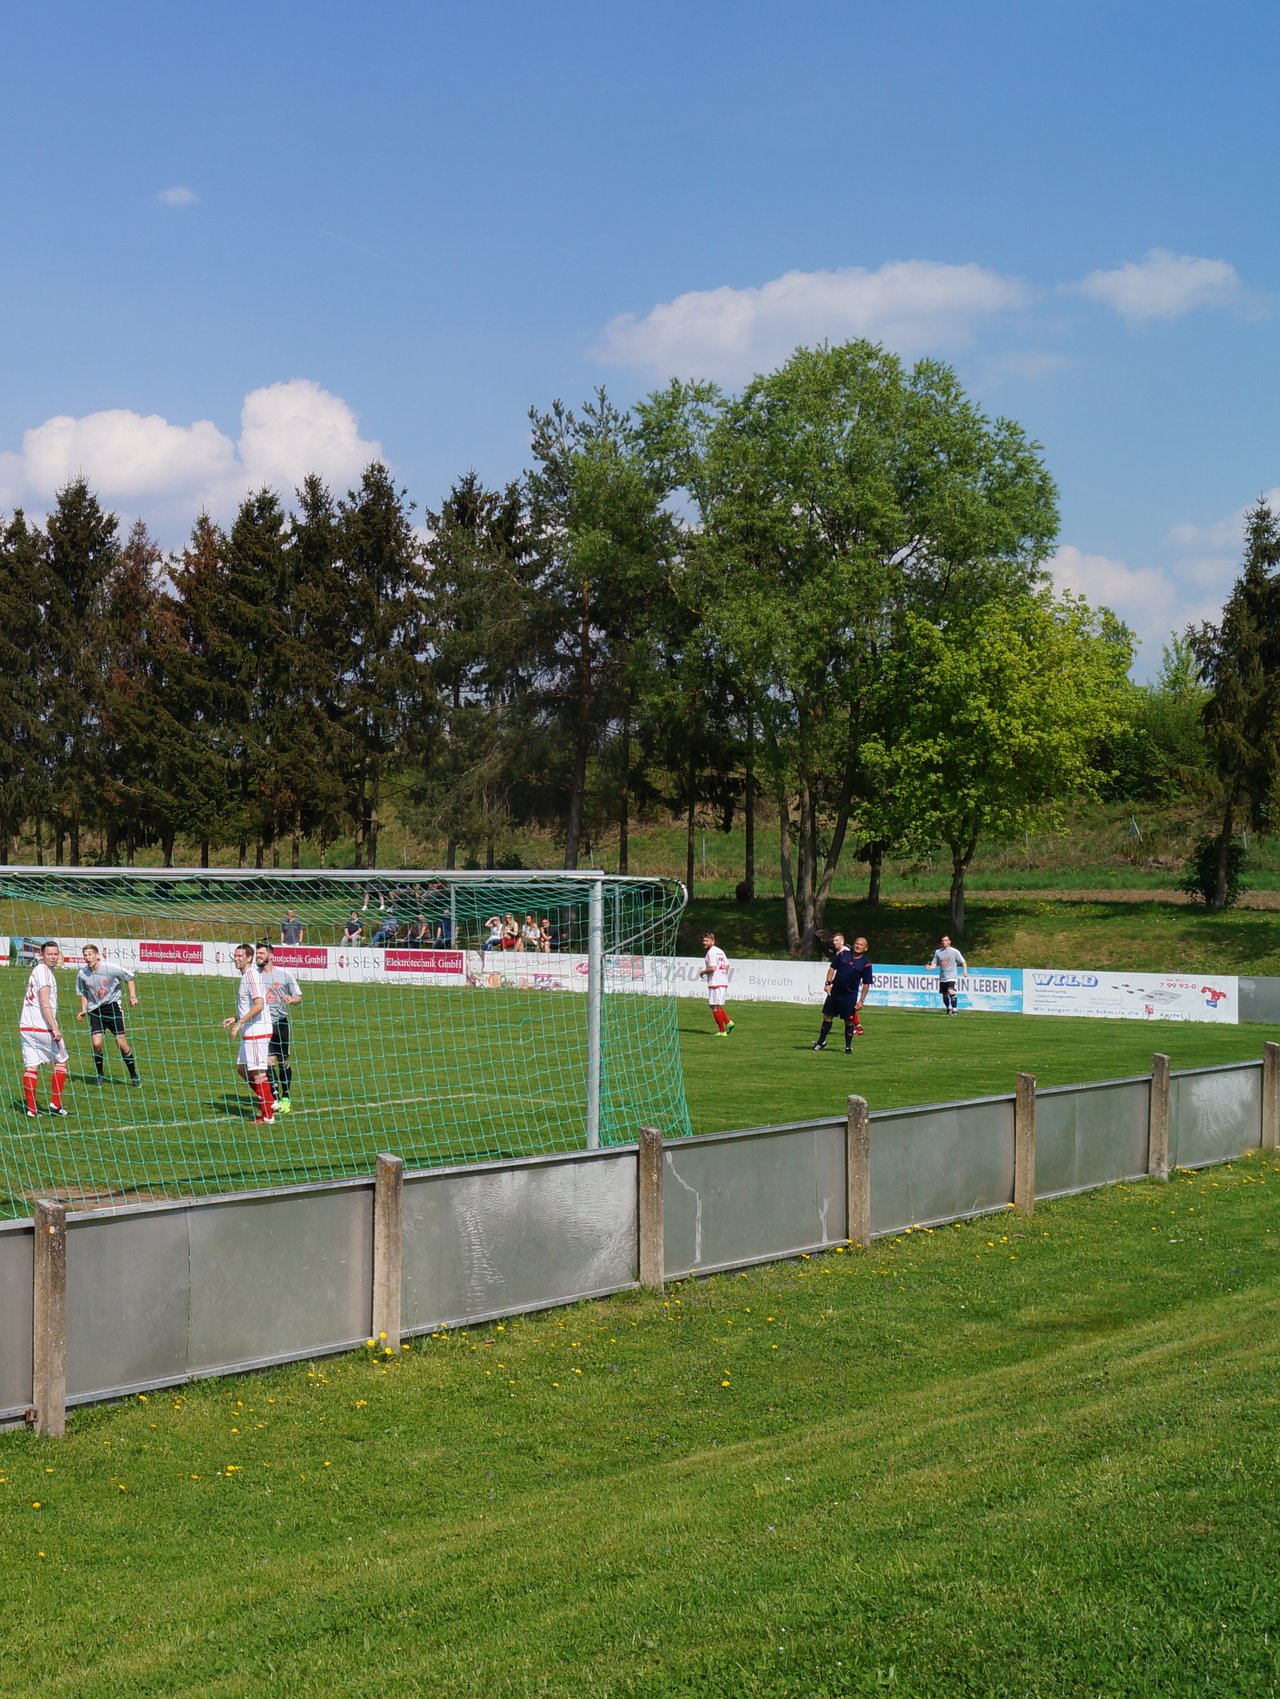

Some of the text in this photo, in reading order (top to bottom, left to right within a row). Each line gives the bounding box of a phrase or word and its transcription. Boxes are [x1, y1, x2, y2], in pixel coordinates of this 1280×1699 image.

[182, 951, 203, 960] GmbH
[305, 955, 327, 964] GmbH
[386, 957, 436, 968] Elektrotechnik
[438, 959, 462, 969] GmbH
[748, 975, 793, 987] Bayreuth
[907, 976, 939, 991] NICHT
[973, 979, 1007, 993] LEBEN
[1032, 973, 1099, 987] WILD
